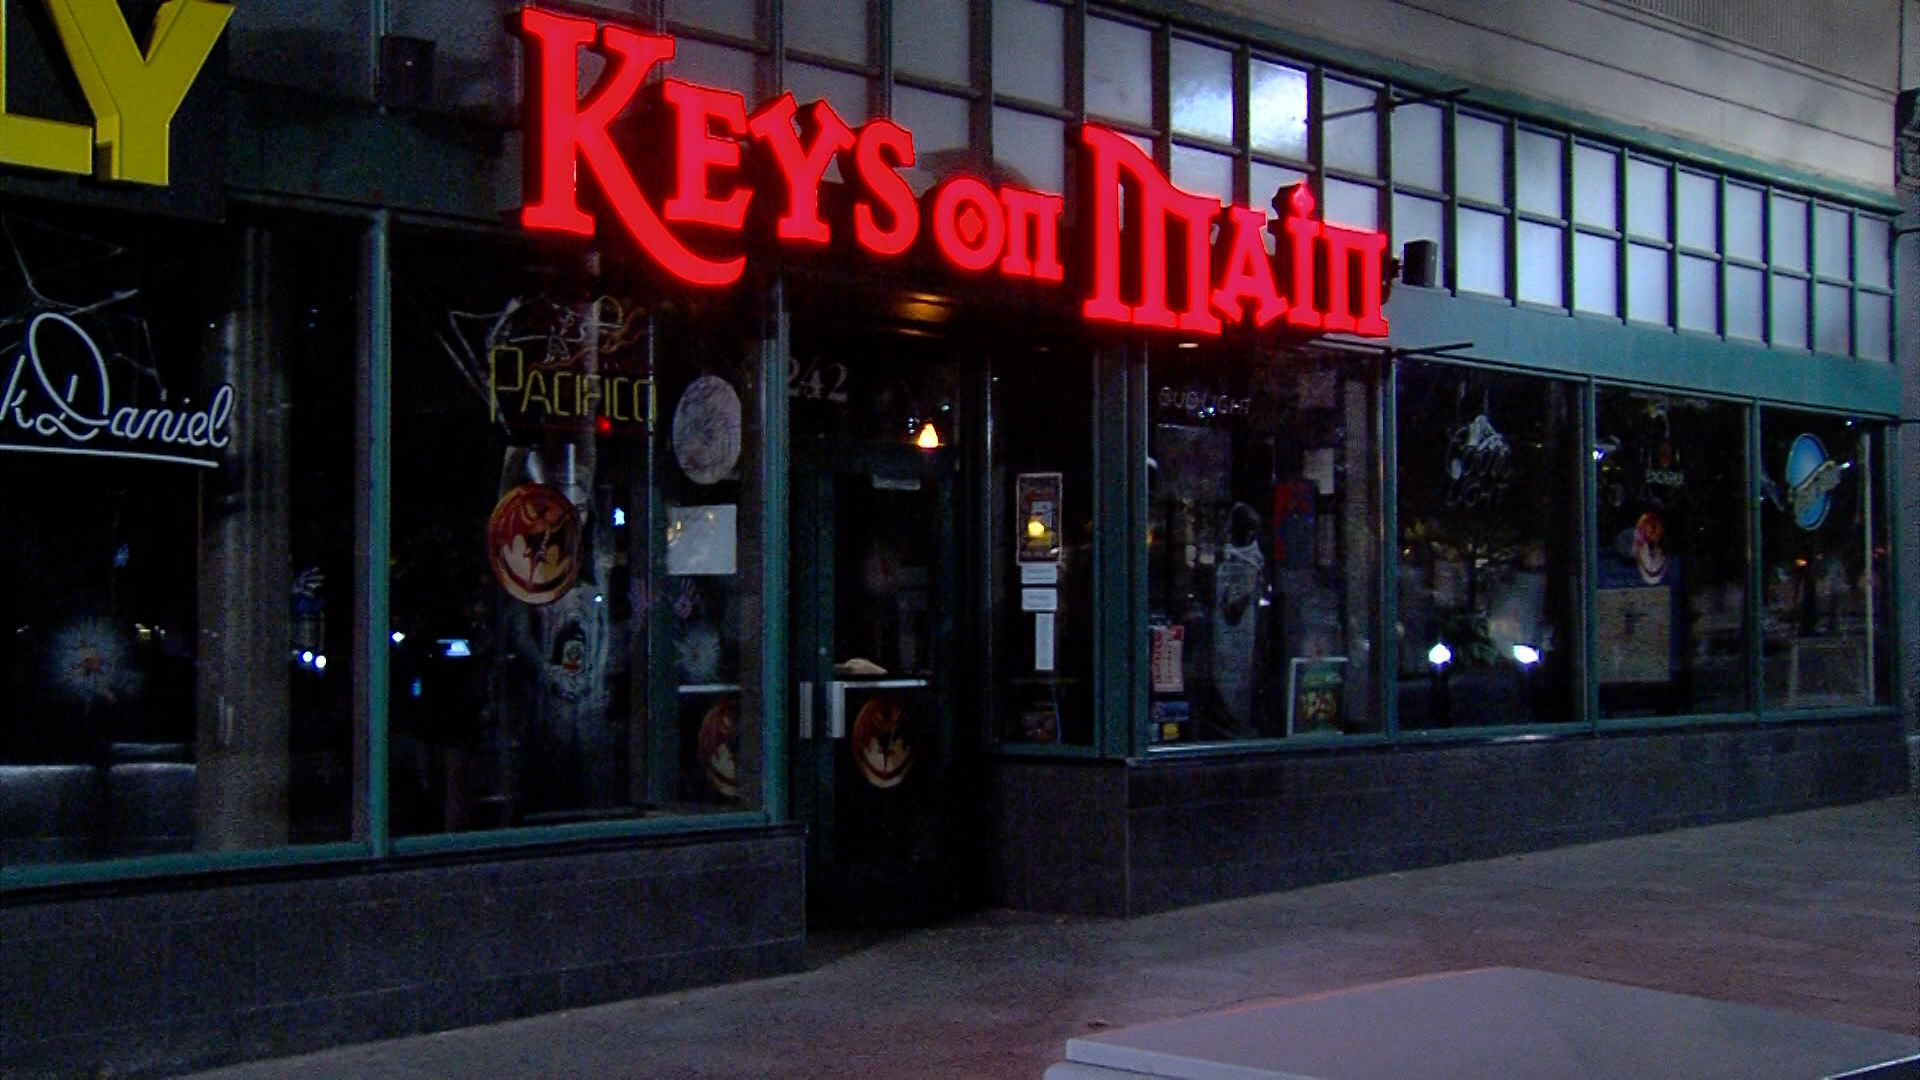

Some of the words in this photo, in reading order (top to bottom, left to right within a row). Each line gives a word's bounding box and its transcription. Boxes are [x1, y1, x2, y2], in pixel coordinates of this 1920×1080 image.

[522, 7, 920, 287] KEYS
[29, 311, 235, 449] Daniel
[786, 350, 849, 402] 242
